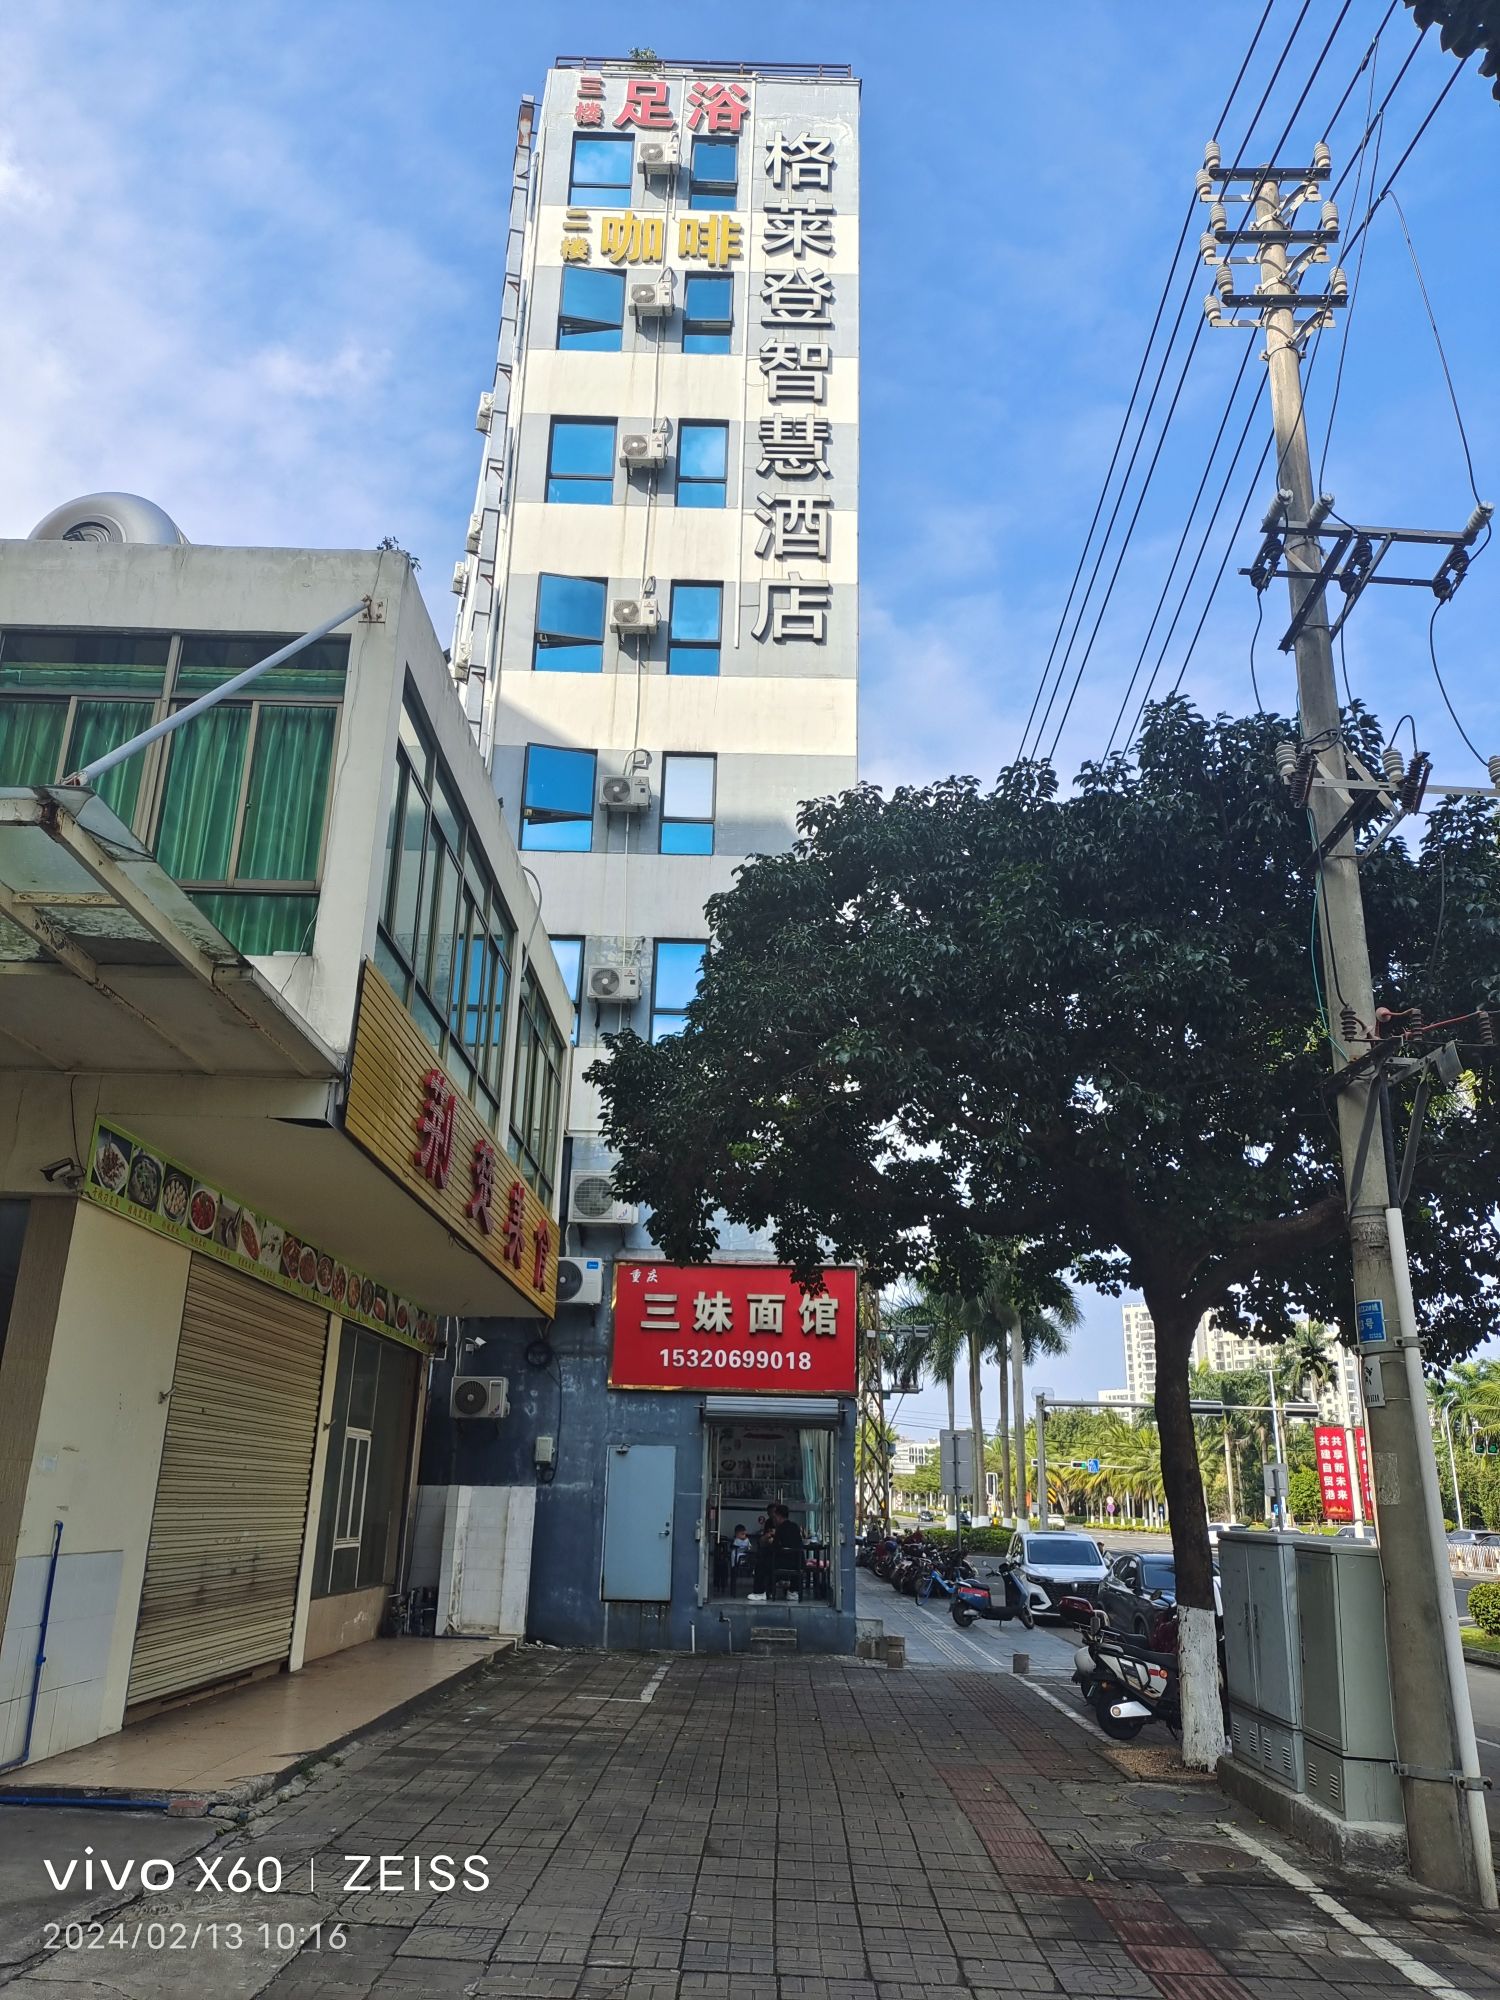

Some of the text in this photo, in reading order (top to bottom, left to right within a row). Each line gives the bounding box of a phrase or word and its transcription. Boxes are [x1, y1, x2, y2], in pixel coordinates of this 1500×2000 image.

[574, 77, 749, 133] 三楼 足浴
[560, 210, 743, 267] 二楼 咖啡
[750, 130, 834, 646] 格莱登智慧酒店
[629, 1268, 659, 1284] 重庆
[640, 1290, 839, 1336] 三妹面馆
[659, 1348, 812, 1370] 15320699018
[1319, 1435, 1336, 1500] 共建自贸港
[1331, 1435, 1348, 1500] 共享新未来
